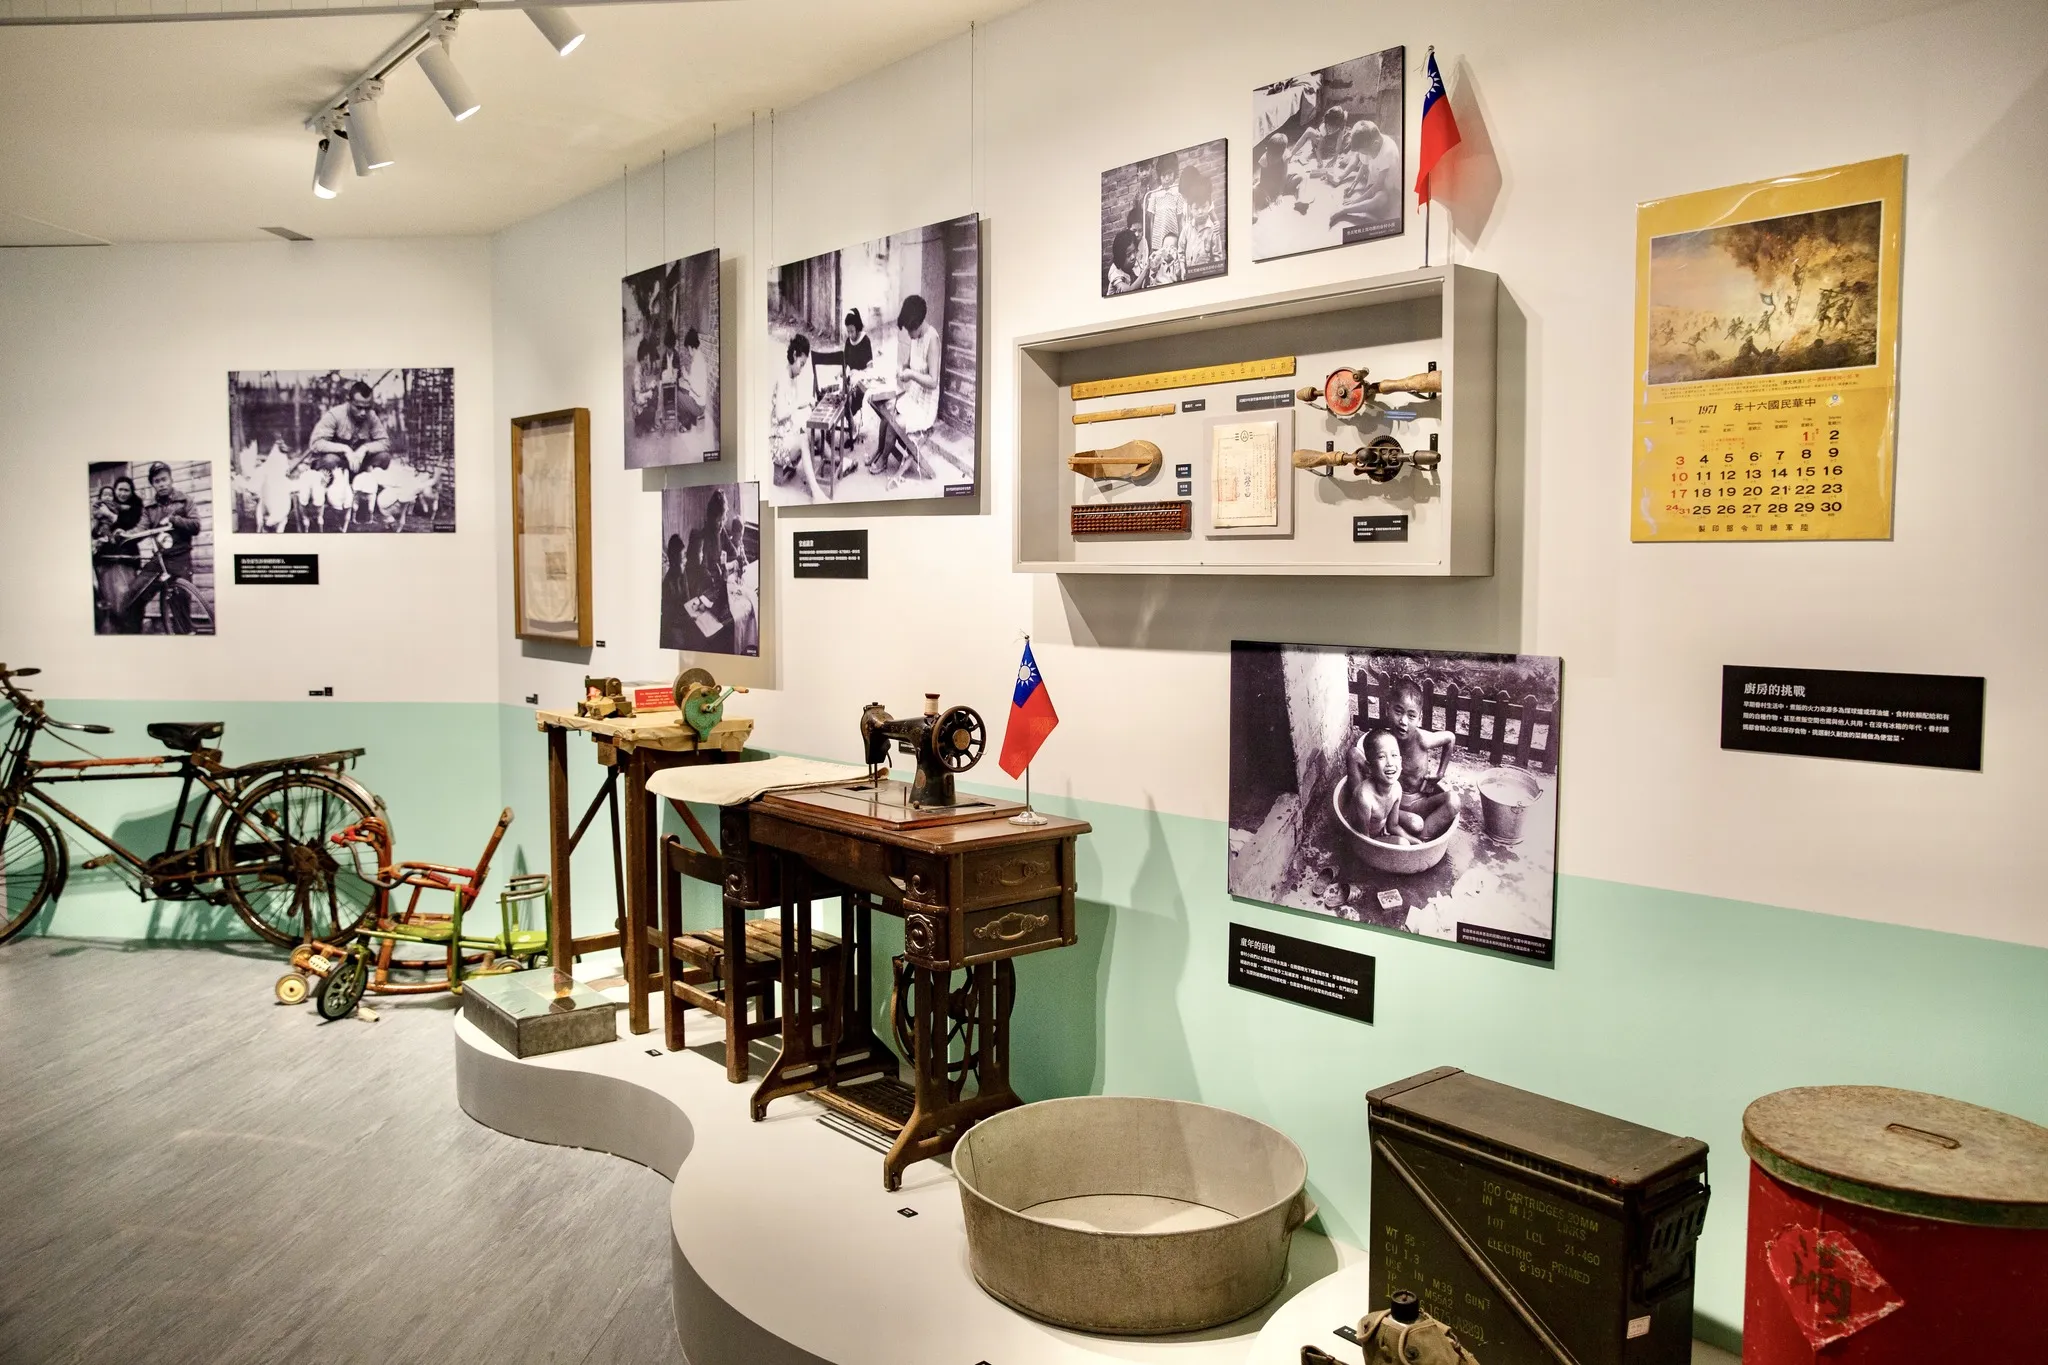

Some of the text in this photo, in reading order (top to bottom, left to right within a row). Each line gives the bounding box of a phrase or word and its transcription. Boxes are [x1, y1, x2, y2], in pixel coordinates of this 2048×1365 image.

[1698, 405, 1717, 415] 1971
[1803, 430, 1839, 441] 1 2
[1676, 448, 1839, 465] 3 4 5 6 7 8 9
[1672, 465, 1843, 482] 10 11 12 13 14 15 16
[1671, 483, 1842, 498] 17 18 19 20 21 22 23
[1693, 506, 1711, 515] 25
[1717, 505, 1736, 514] 26
[1742, 504, 1761, 514] 27
[1768, 503, 1788, 513] 28
[1794, 503, 1814, 512] 29
[1820, 502, 1842, 512] 30
[1744, 682, 1805, 697] 廚房的挑戰
[1482, 1193, 1493, 1206] IN
[1482, 1180, 1501, 1197] 100
[1505, 1190, 1565, 1220] CARTRIDGES
[1385, 1225, 1399, 1240] WT
[1487, 1237, 1590, 1285] ELECTRIC PRIMED
[1385, 1256, 1402, 1272] USE
[1414, 1269, 1424, 1282] IN
[1464, 1293, 1485, 1311] GUN
